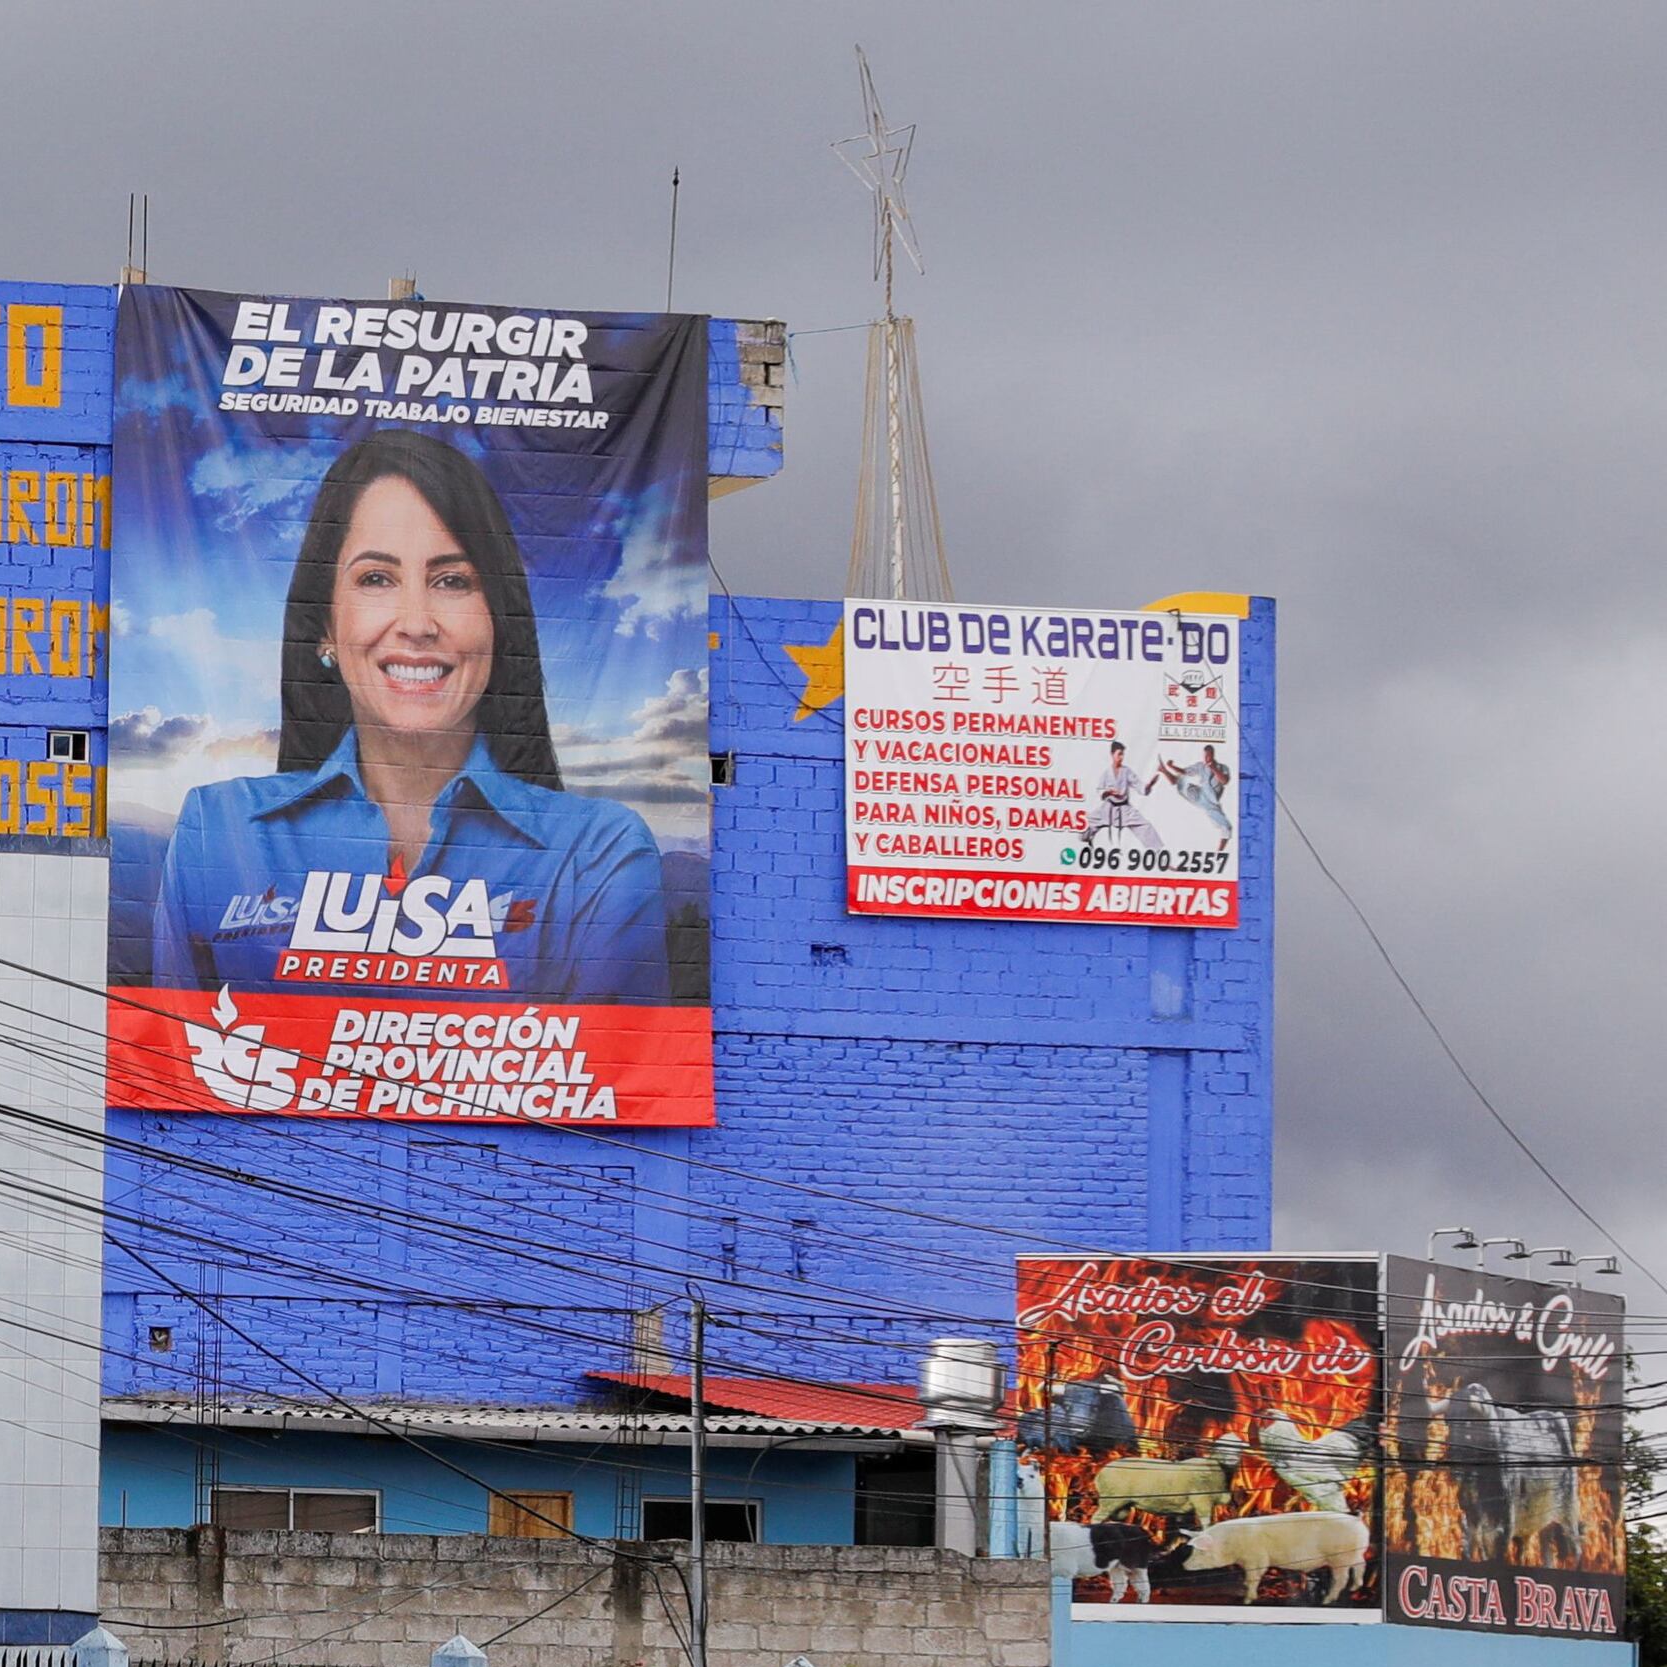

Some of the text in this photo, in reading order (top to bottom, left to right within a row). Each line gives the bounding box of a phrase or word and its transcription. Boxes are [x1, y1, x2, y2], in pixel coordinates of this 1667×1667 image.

[230, 302, 588, 359] EL RESURGIR
[221, 345, 593, 404] DE LA PATRIA
[218, 391, 610, 431] SEGURIDAD TRABAJO BIENESTAR
[853, 607, 953, 653] CLUB
[931, 661, 1071, 706] 空手道
[853, 707, 1117, 739] CURSOS PERMANENTES
[853, 739, 1052, 767] Y VACACIONALES
[853, 771, 1084, 800] DEFENSA PERSONAL
[853, 800, 1088, 832] PARA NIÑOS, DAMAS
[854, 832, 1025, 860] Y CABALLEROS
[1078, 846, 1229, 874] 096 900 2557
[856, 874, 1230, 916] INSCRIPCIONES ABIERTAS
[280, 954, 503, 987] PRESIDENTA
[330, 1006, 581, 1051] DIRECCIÓN
[319, 1045, 596, 1085] PROVINCIAL
[297, 1077, 619, 1121] DE PICHINCHA
[1017, 1262, 1268, 1327] Asados al
[1536, 1293, 1616, 1381] Grill
[1397, 1564, 1619, 1635] CASTA BRAVA
